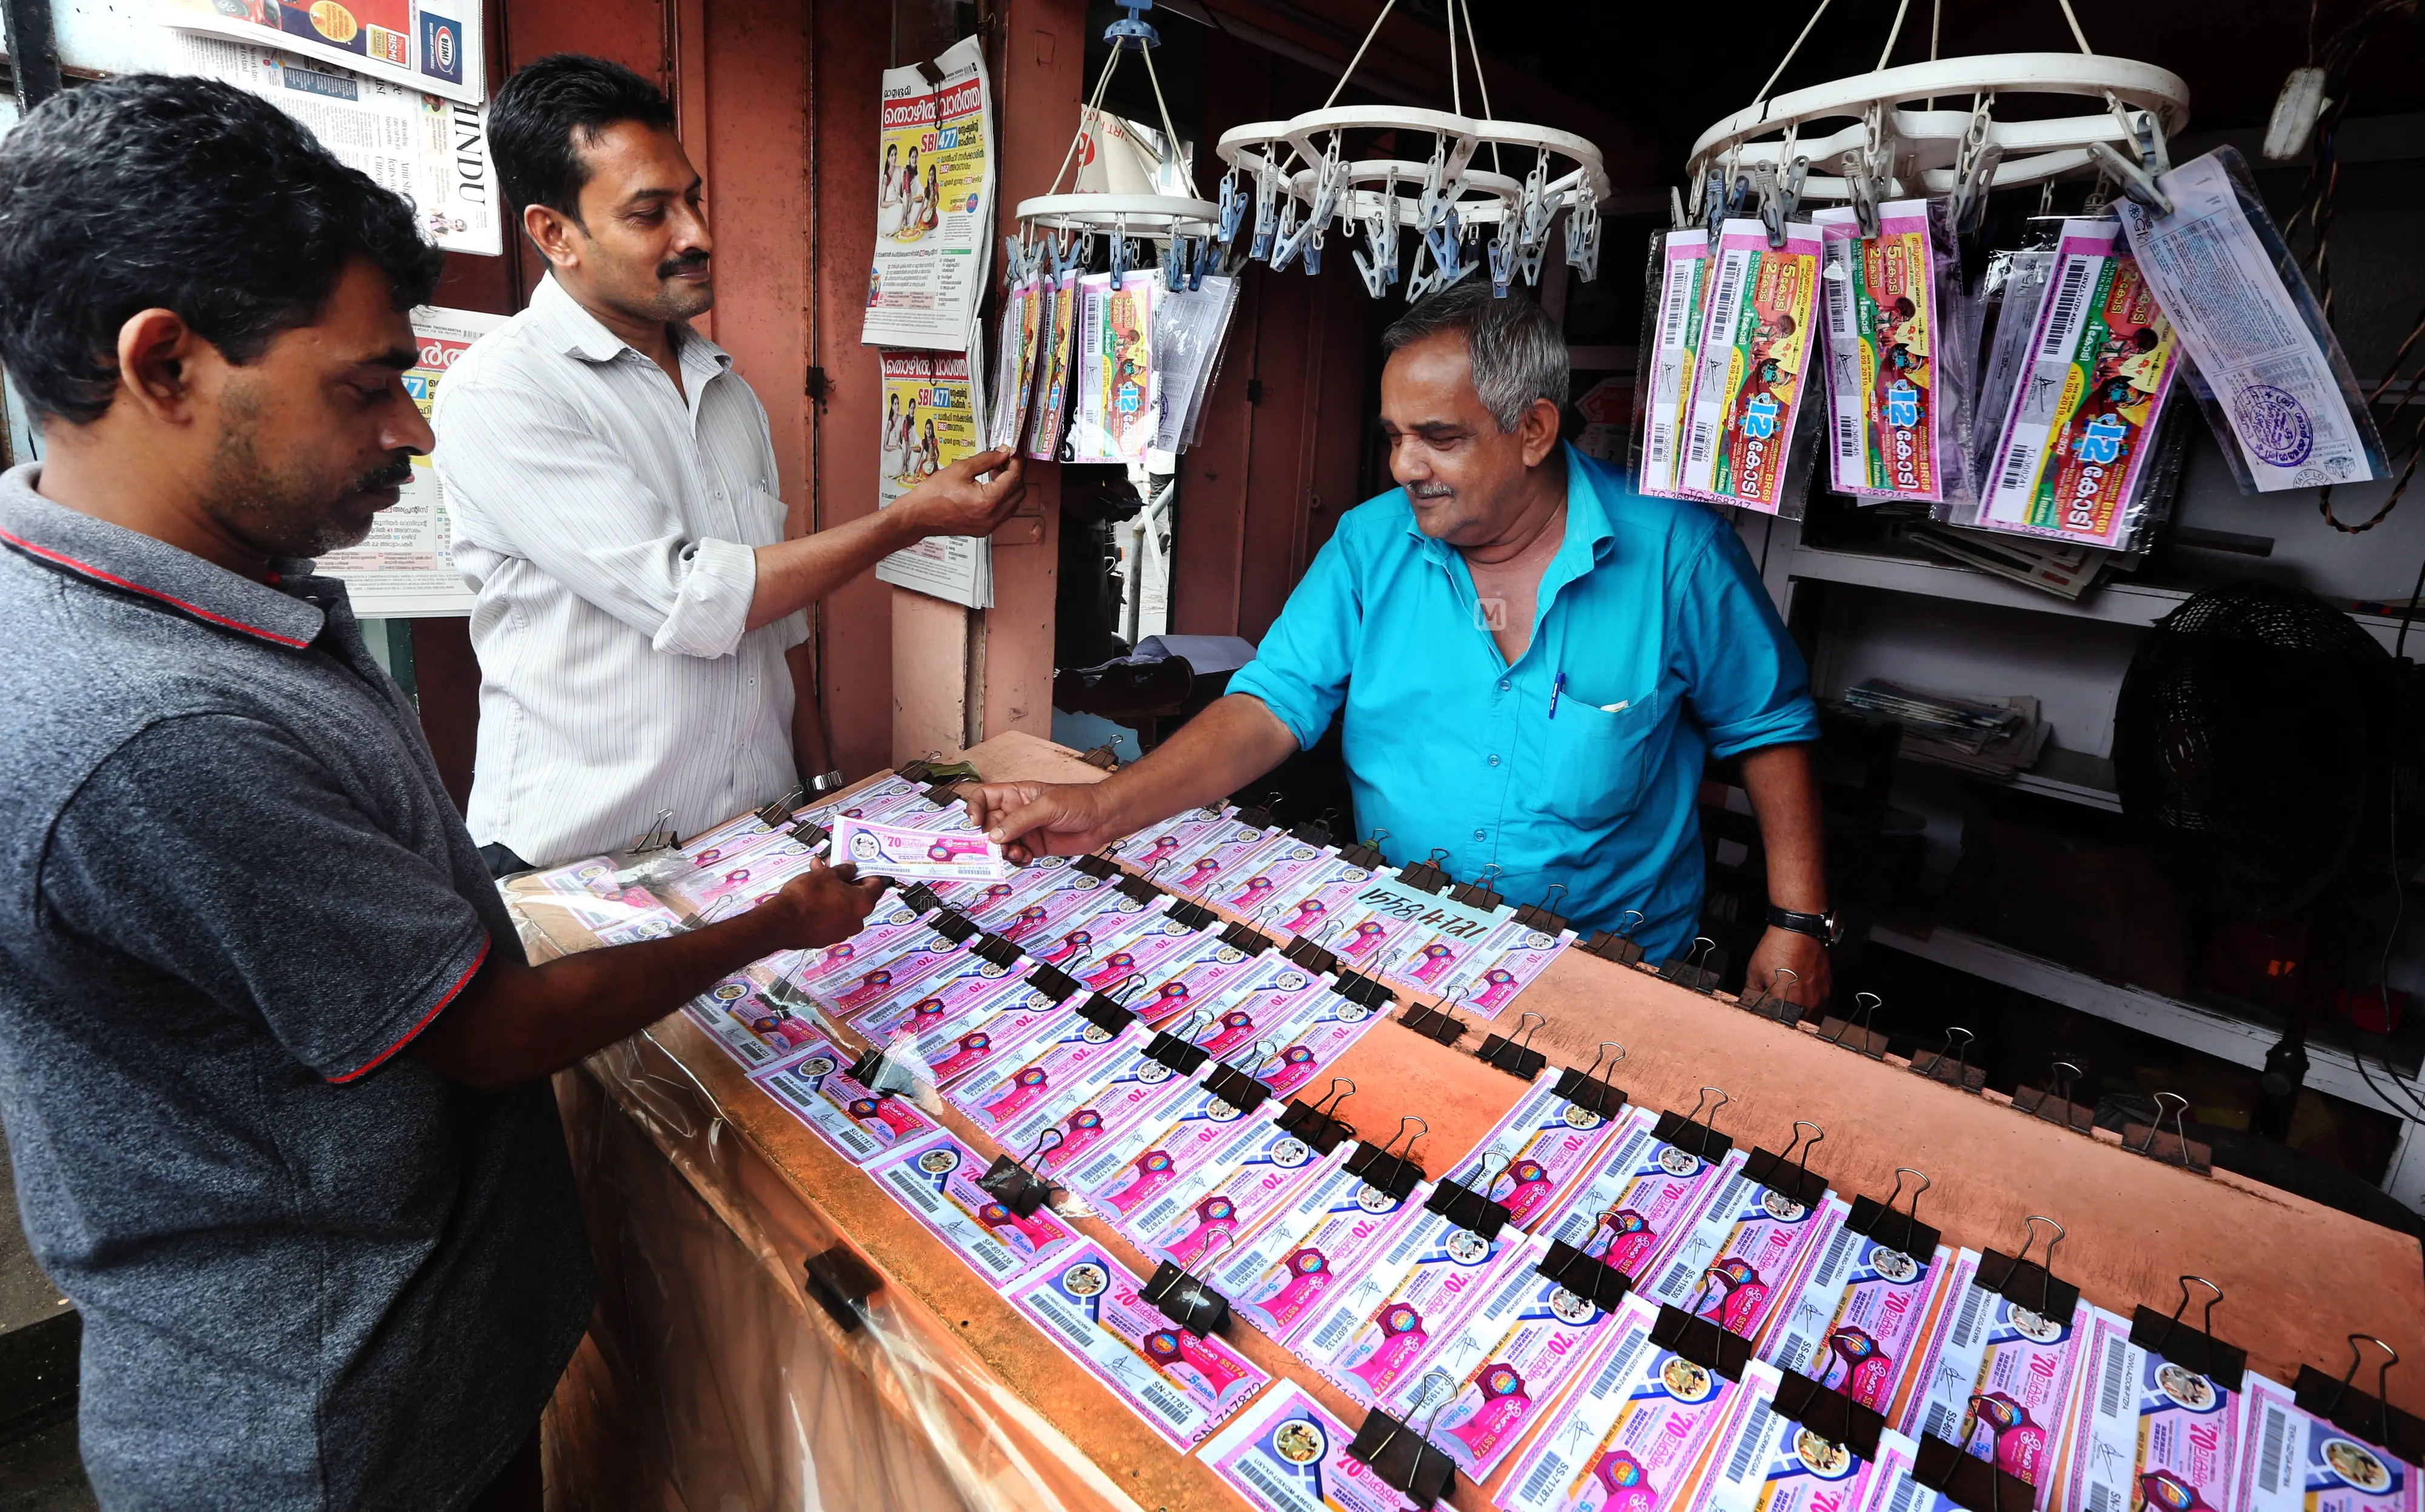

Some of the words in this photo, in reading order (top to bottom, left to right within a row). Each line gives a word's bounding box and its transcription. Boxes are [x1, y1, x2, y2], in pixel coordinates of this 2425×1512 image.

[387, 33, 398, 61] BISMI
[921, 132, 938, 153] SBI
[938, 129, 957, 148] 477
[918, 389, 932, 406] SBI
[934, 389, 949, 406] 477
[1662, 424, 1671, 463] TG-368248
[1701, 423, 1714, 463] TG-368247
[1851, 418, 1859, 456] TJ-368245
[1739, 439, 1769, 499] കോടി
[1769, 439, 1780, 473] THIRUVONAM
[1895, 429, 1919, 490] കോടി
[2015, 446, 2038, 490] TJ-368241
[1761, 473, 1773, 501] BR69
[1920, 462, 1929, 490] BR69
[2062, 463, 2113, 536] കോടി
[903, 1112, 923, 1131] SS174
[848, 1126, 875, 1151] SU-717872
[1042, 1219, 1065, 1241] SS174
[1144, 1202, 1180, 1235] SO-717872
[1562, 1216, 1590, 1246] ST-119532
[981, 1237, 1014, 1267] SP-607138
[1233, 1256, 1268, 1288] SS-119531
[1670, 1268, 1696, 1300] SS-119530
[1132, 1299, 1166, 1330] ലക്ഷം
[1276, 1303, 1299, 1327] SS174
[1730, 1314, 1747, 1336] SS174
[1109, 1329, 1120, 1340] DATE
[1323, 1313, 1358, 1352] SS-607132
[1219, 1356, 1245, 1380] SS174
[1370, 1368, 1396, 1395] SS174
[1151, 1379, 1194, 1417] SN-717872
[1614, 1413, 1624, 1425] DATE
[1472, 1432, 1497, 1460] SS174
[1645, 1431, 1678, 1474] ലക്ഷം
[1533, 1461, 1570, 1507] SS-717871
